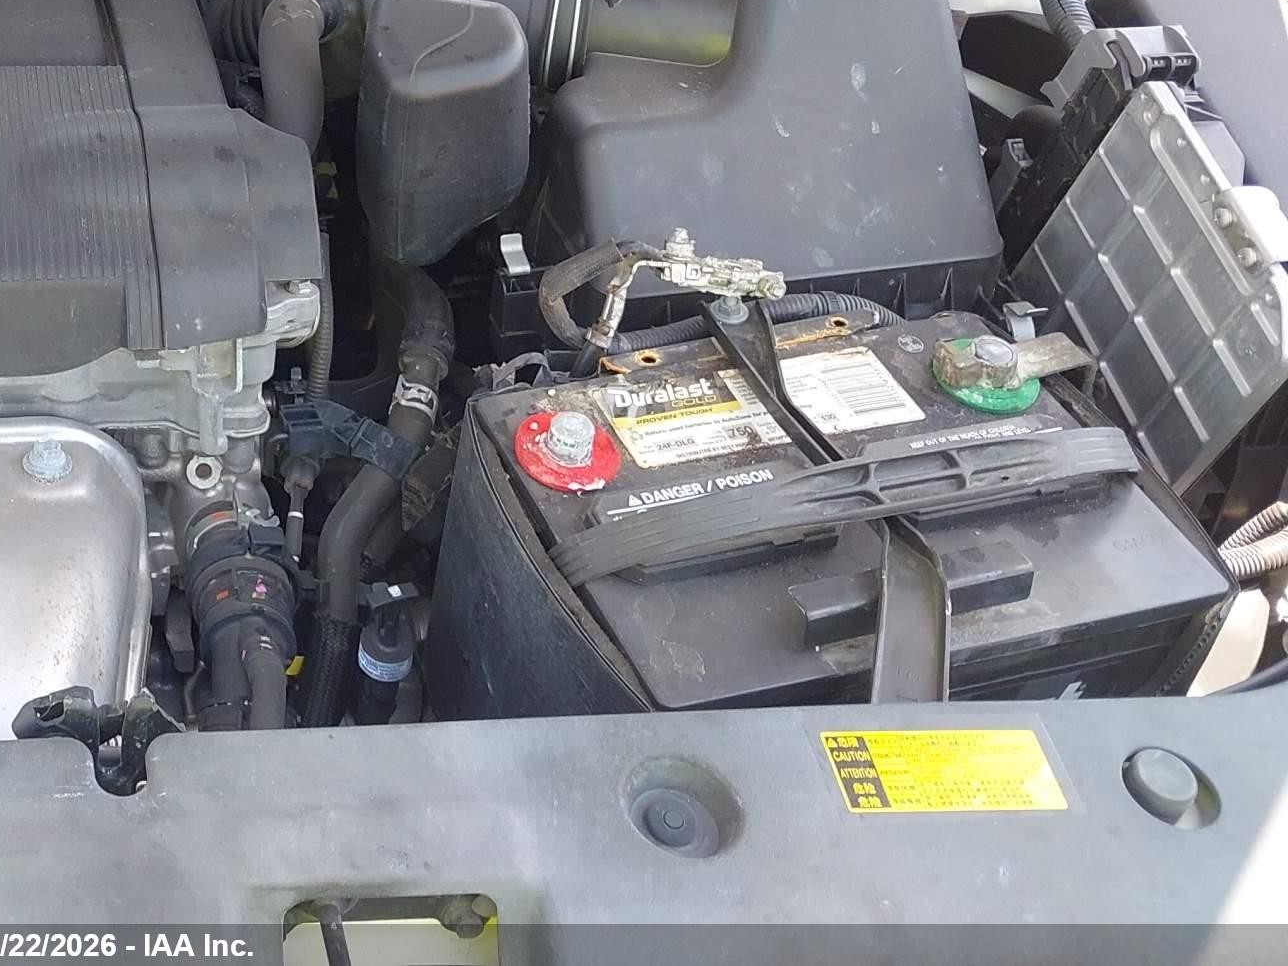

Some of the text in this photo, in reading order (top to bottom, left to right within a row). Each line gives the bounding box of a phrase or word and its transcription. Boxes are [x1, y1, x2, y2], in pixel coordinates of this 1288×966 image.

[608, 378, 714, 408] Duralast
[671, 394, 717, 408] GOLD
[636, 411, 677, 425] PROVEN
[727, 425, 754, 437] 750
[640, 482, 705, 505] DANGER
[715, 469, 774, 491] POISON
[833, 751, 872, 762] CAUTION
[839, 767, 878, 779] ATTENTION
